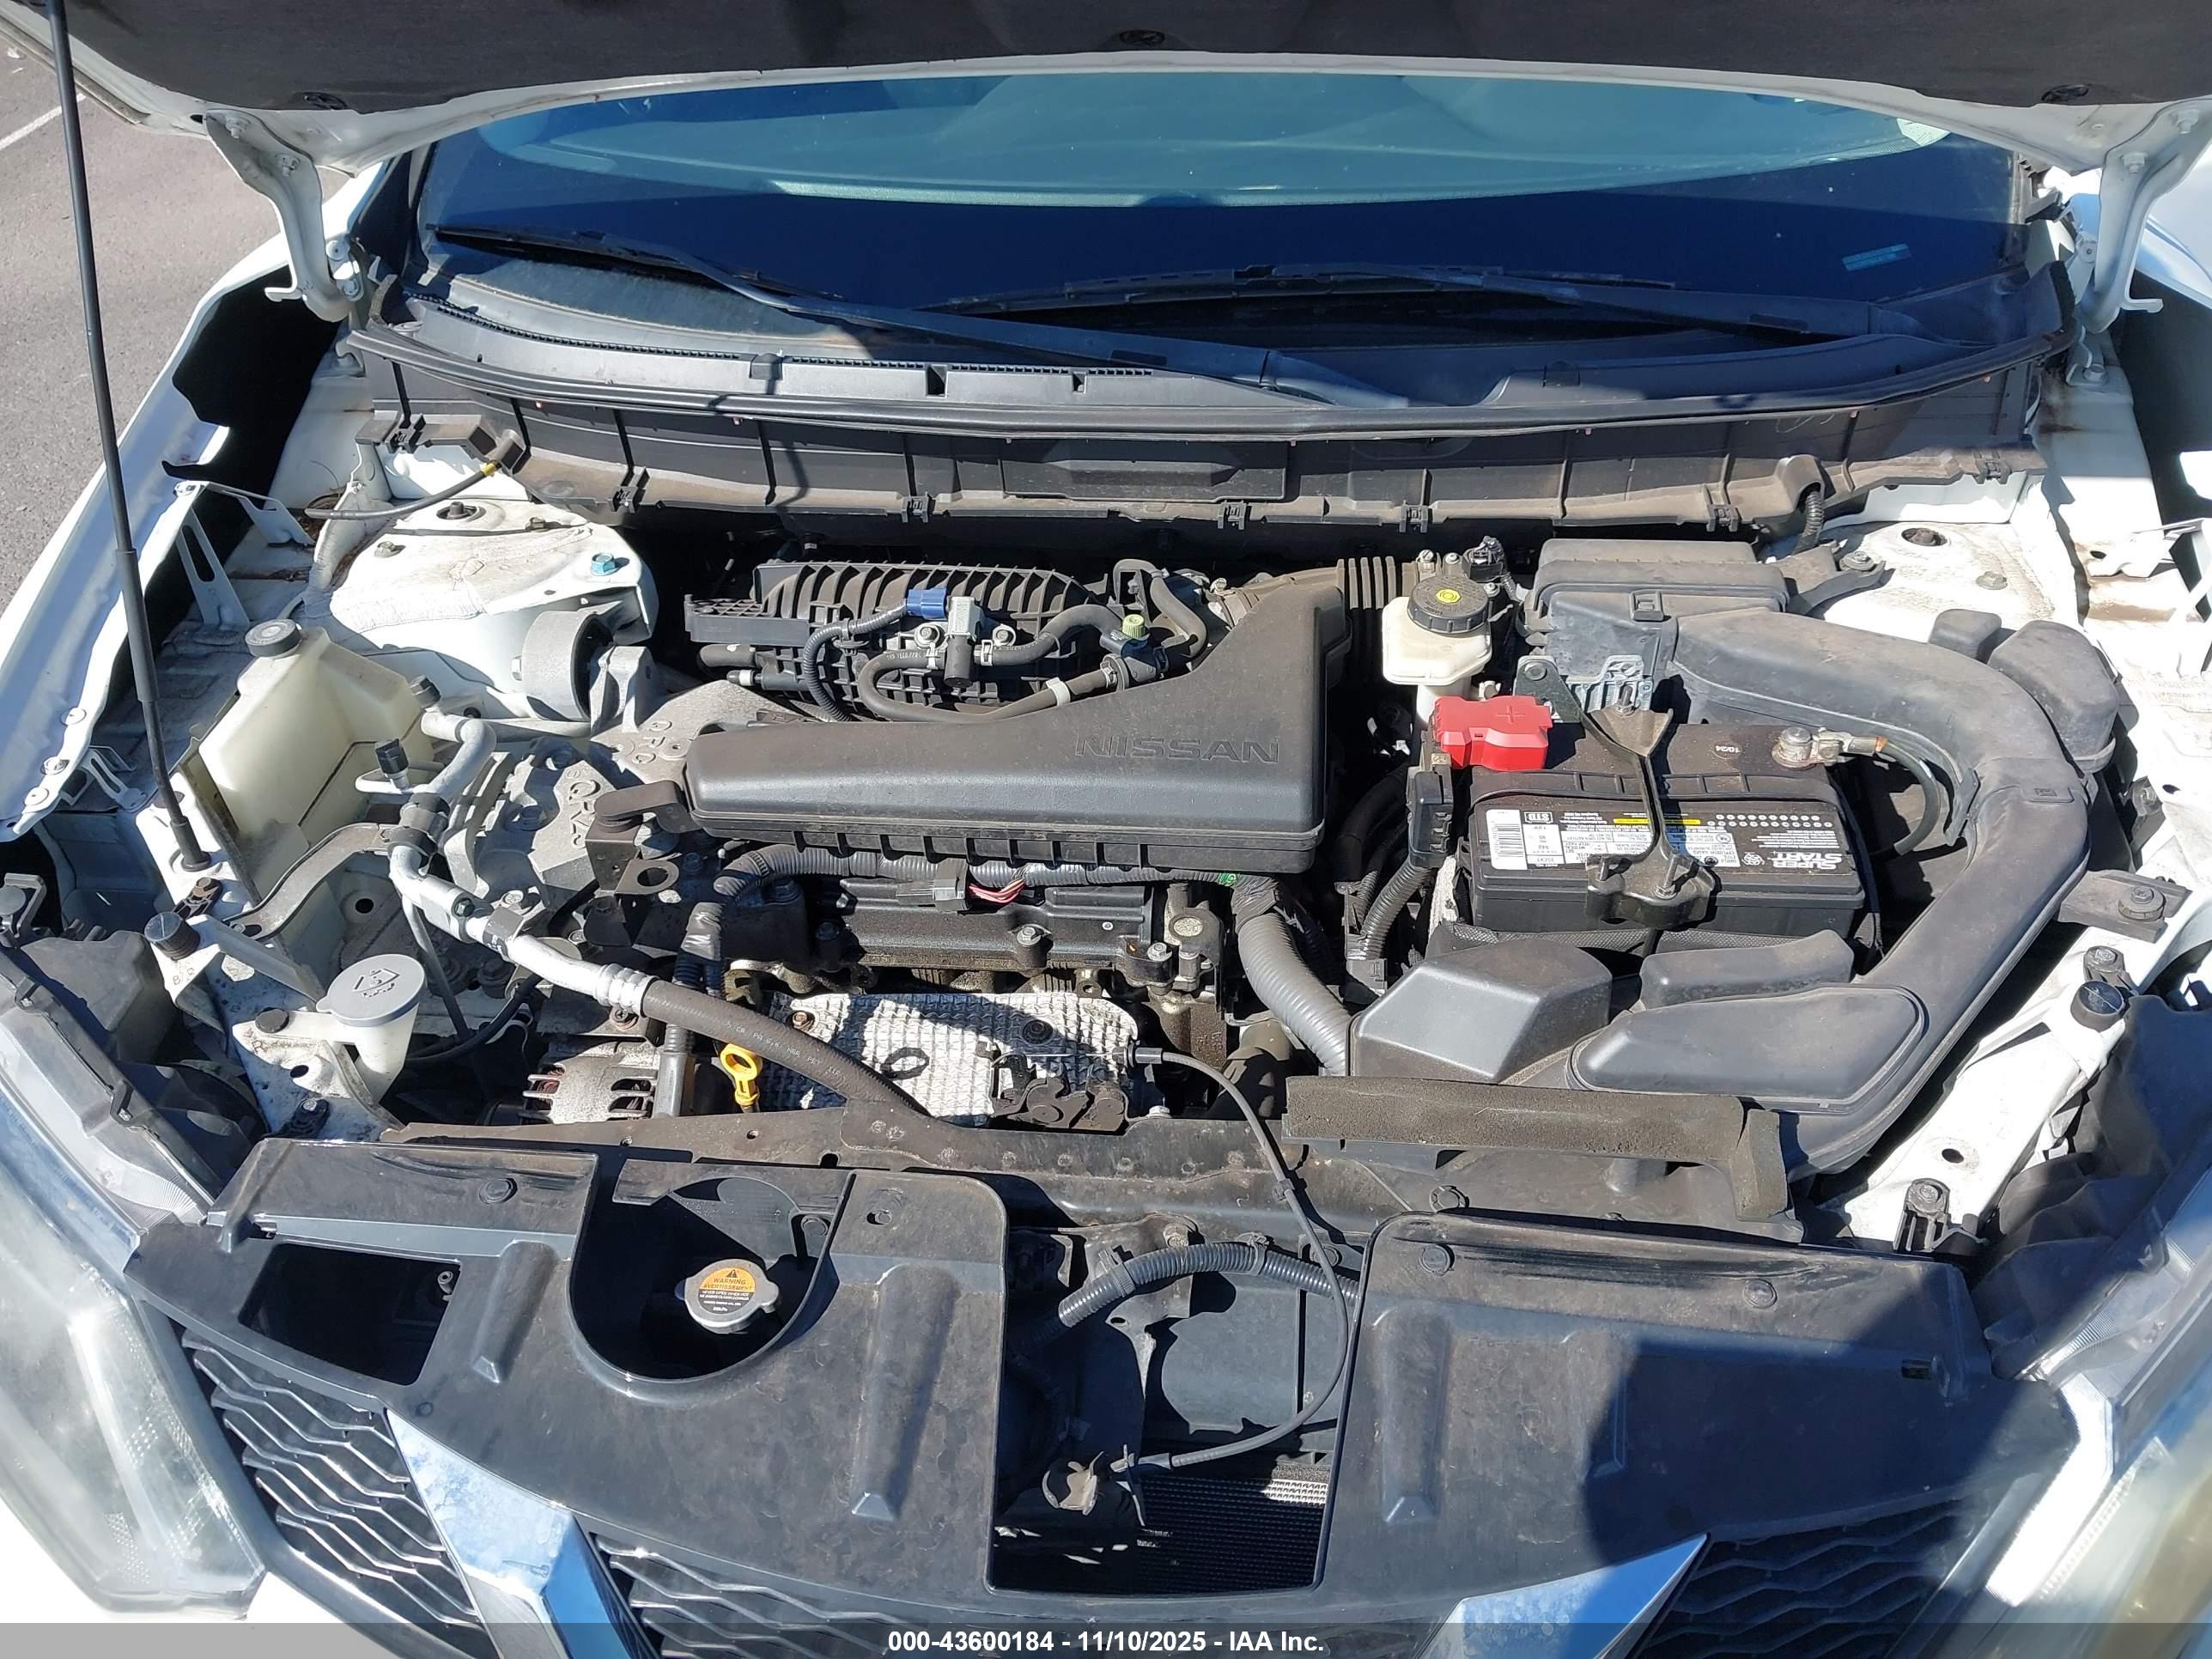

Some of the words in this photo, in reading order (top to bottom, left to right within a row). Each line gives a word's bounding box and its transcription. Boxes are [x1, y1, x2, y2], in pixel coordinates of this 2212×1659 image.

[1074, 734, 1279, 763] NISSAN
[1770, 852, 1843, 864] START
[1772, 860, 1837, 870] SUPER
